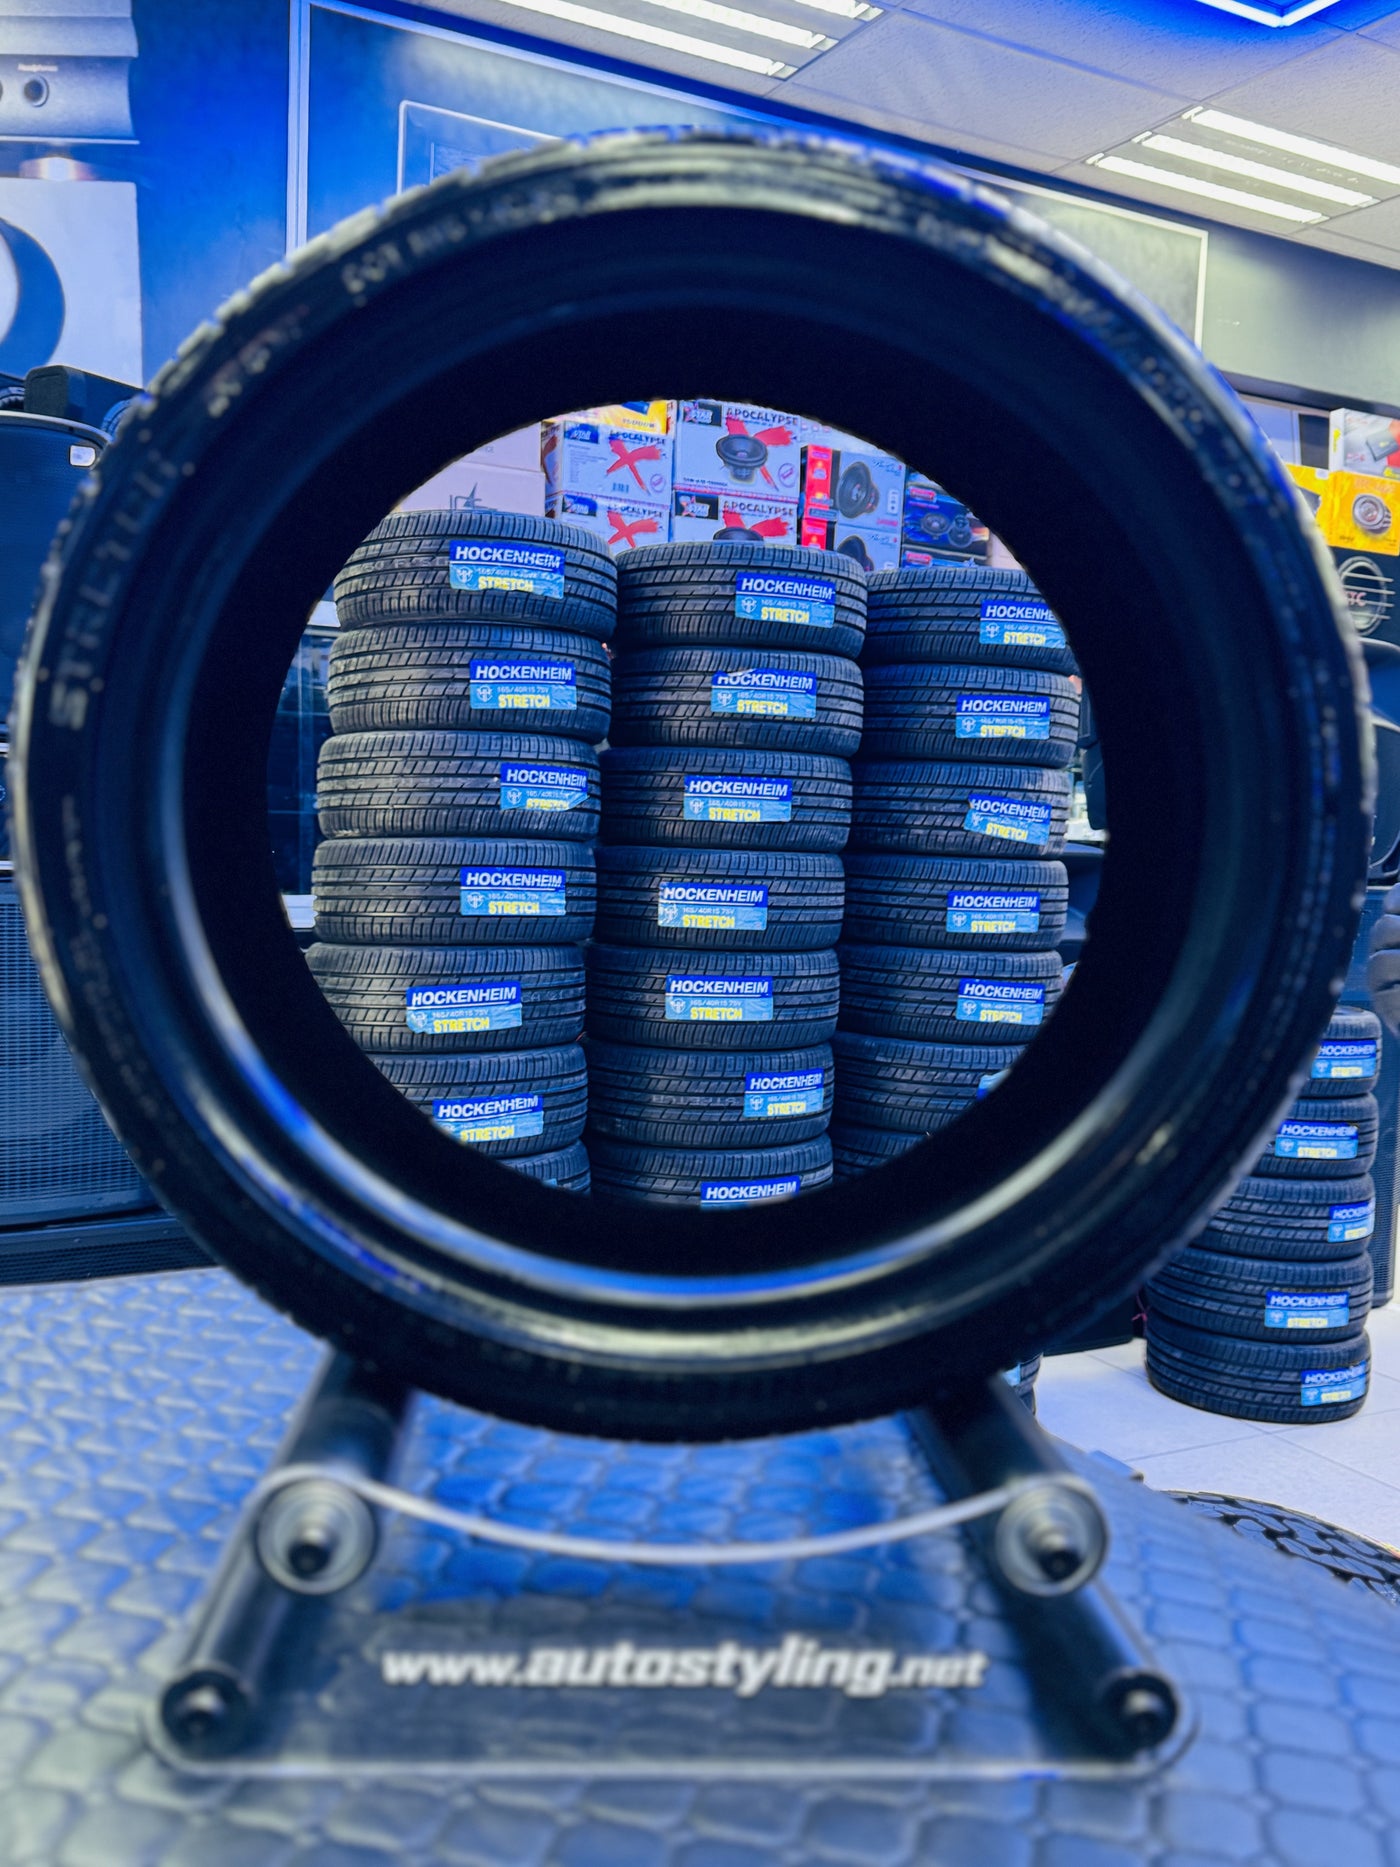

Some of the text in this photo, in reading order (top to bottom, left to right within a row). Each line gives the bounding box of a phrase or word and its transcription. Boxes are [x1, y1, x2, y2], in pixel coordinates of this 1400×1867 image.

[726, 407, 798, 425] APOCALYPSE
[724, 501, 794, 516] APOCALYPSE
[456, 546, 561, 568] HOCKENHEIM
[478, 576, 534, 592] STRETCH
[741, 578, 833, 599] HOCKENHEIM
[761, 607, 810, 623] STRETCH
[986, 605, 1056, 620] HOCKENHE
[475, 665, 572, 680] HOCKENHEIM
[718, 673, 813, 690] HOCKENHEIM
[498, 694, 550, 708] STRETCH
[737, 699, 788, 714] STRETCH
[962, 700, 1047, 713] HOCKENHEIM
[507, 769, 586, 788] HOCKENHEIM
[689, 780, 788, 796] HOCKENHEIM
[708, 807, 760, 821] STRETCH
[972, 799, 1049, 819] HOCKENHEIM
[466, 872, 562, 887] HOCKENHEIM
[664, 887, 764, 902] HOCKENHEIM
[953, 895, 1037, 908] HOCKENHEIM
[488, 901, 540, 914] STRETCH
[682, 915, 735, 928] STRETCH
[670, 980, 769, 994] HOCKENHEIM
[964, 983, 1043, 1000] HOCKENHEIM
[412, 987, 516, 1006] HOCKENHEIM
[690, 1007, 742, 1020] STRETCH
[433, 1017, 490, 1033] STRETCH
[750, 1073, 822, 1090] HOCKENHEIM
[438, 1095, 538, 1118] HOCKENHEIM
[460, 1126, 515, 1142] STRETCH
[706, 1181, 797, 1199] HOCKENHEIM
[382, 1634, 989, 1697] www.autostyling.net
